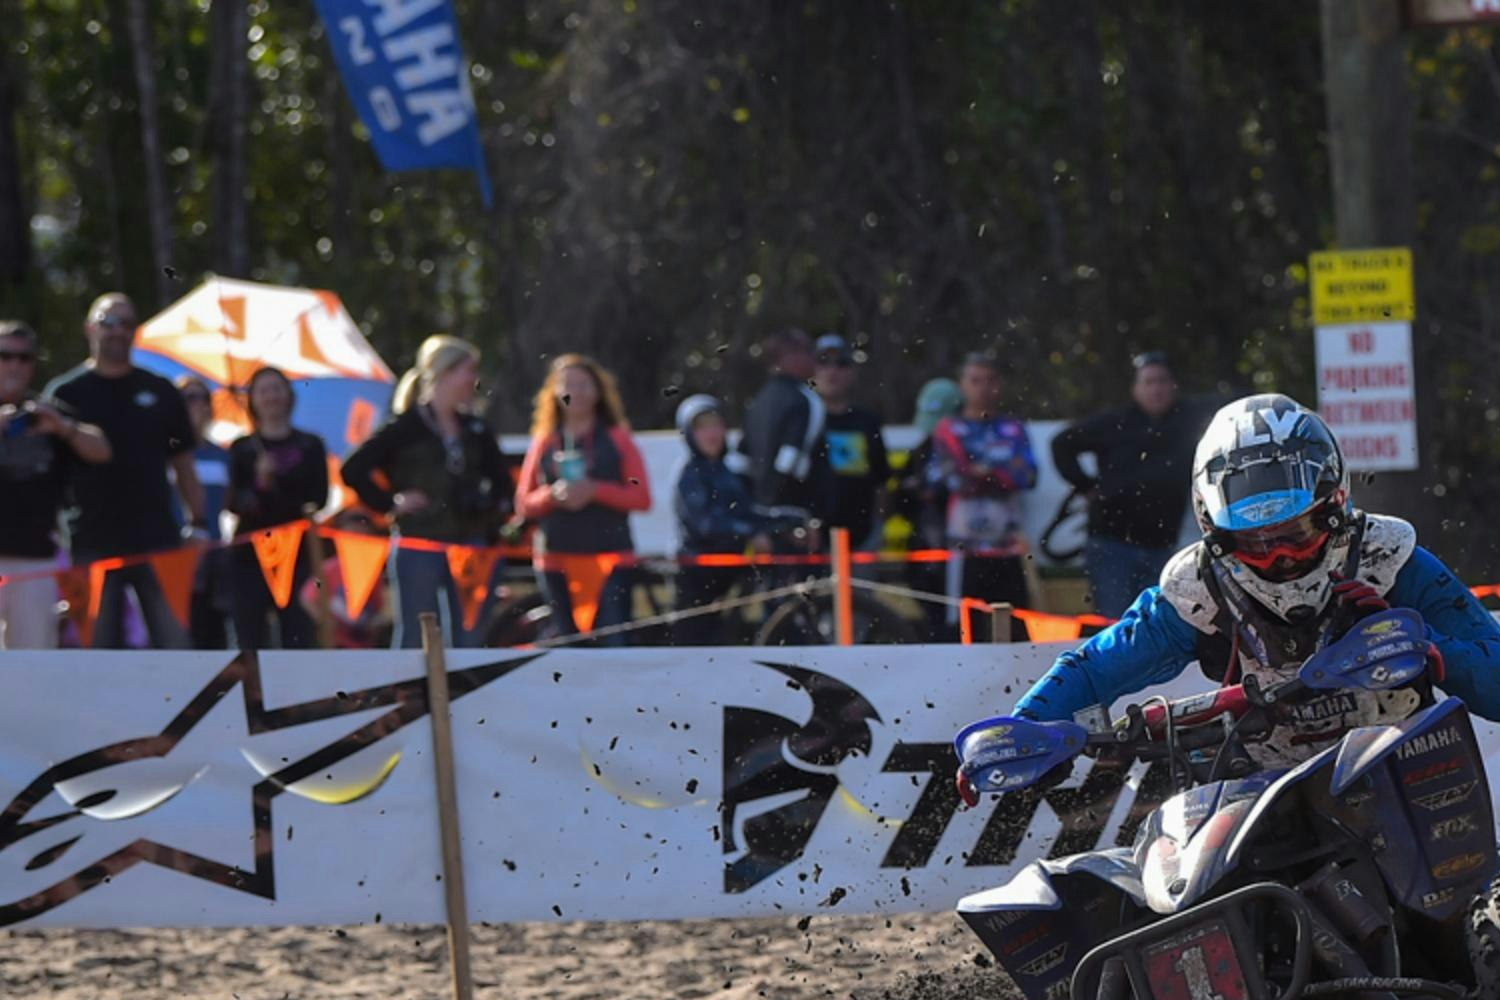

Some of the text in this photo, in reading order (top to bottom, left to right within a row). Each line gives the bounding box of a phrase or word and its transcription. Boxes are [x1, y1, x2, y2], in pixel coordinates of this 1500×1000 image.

[1347, 331, 1375, 354] NO
[1323, 364, 1407, 390] PARKING
[1321, 399, 1414, 425] BETWEEN
[1290, 693, 1353, 721] AMAHA
[1396, 726, 1461, 760] YAMAHA
